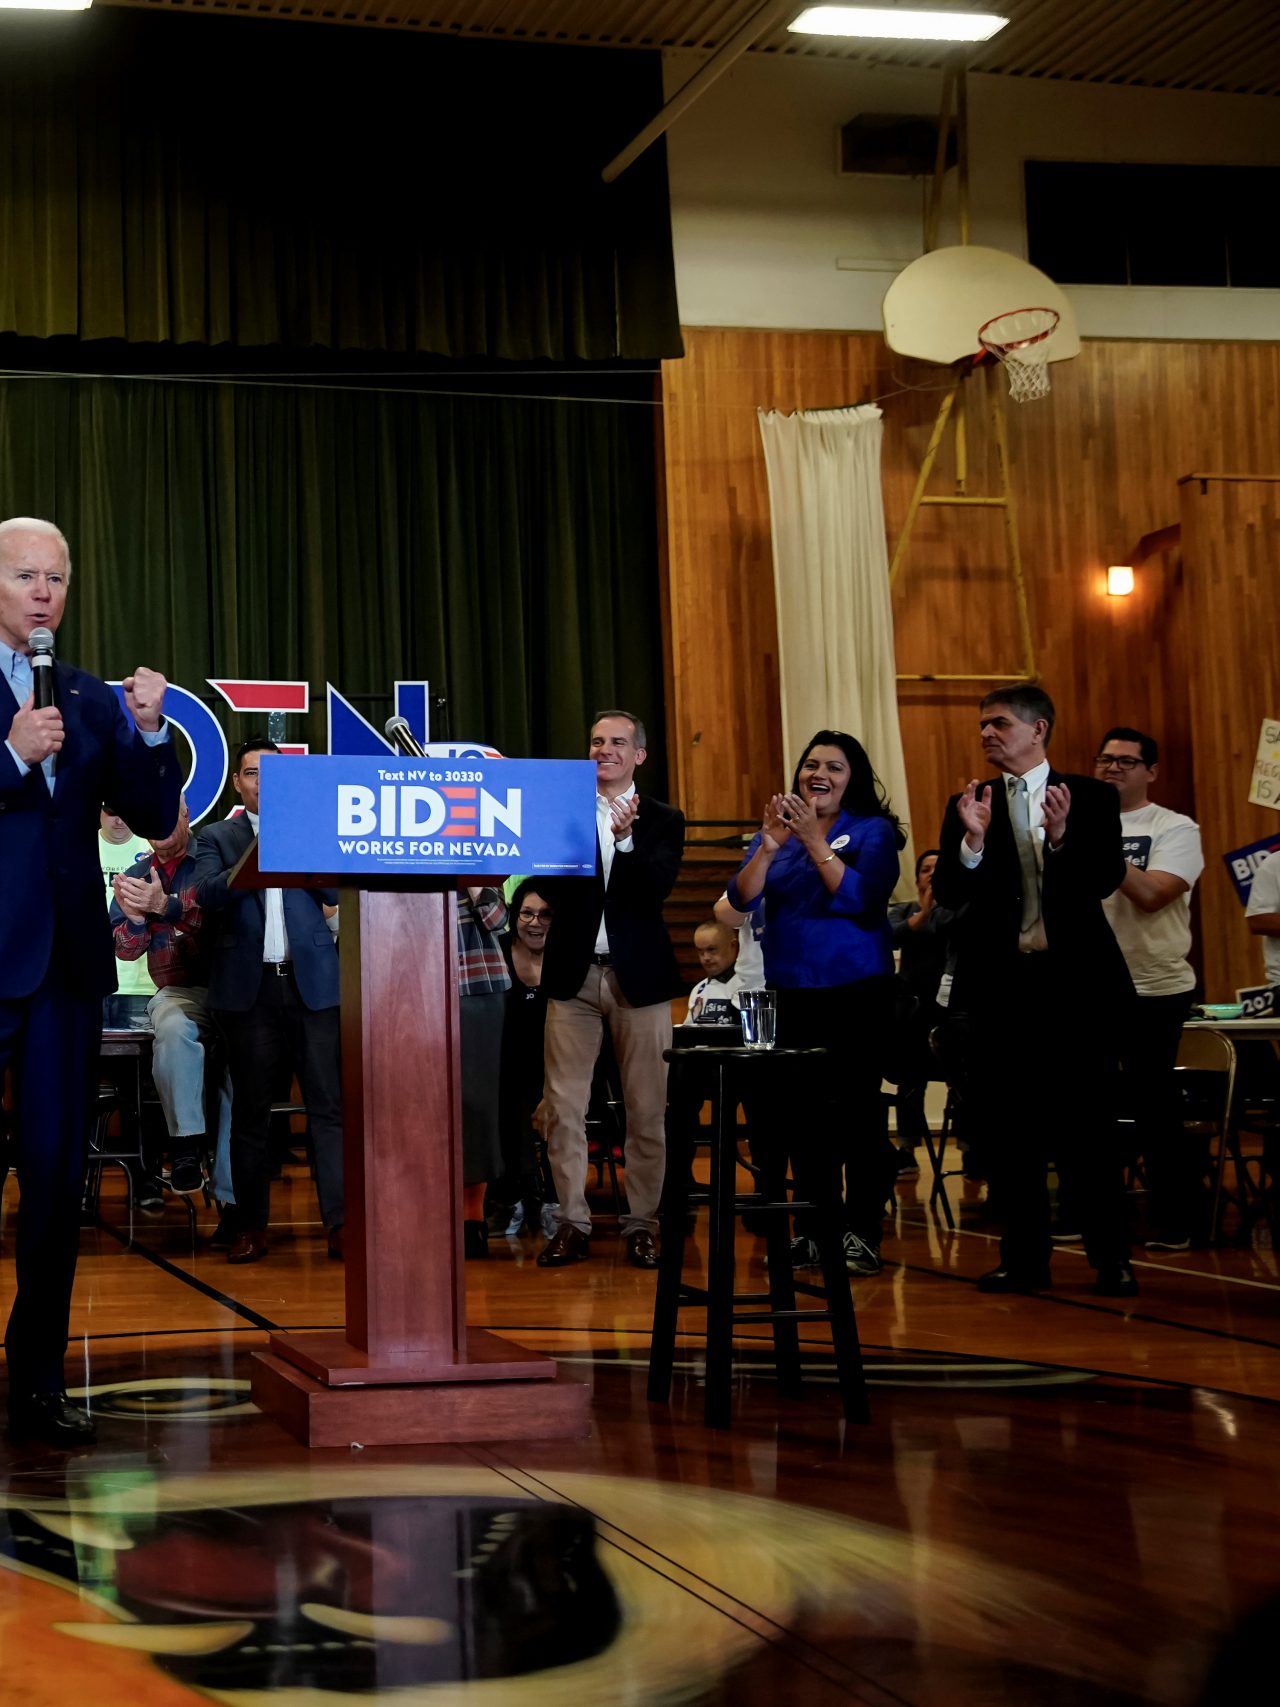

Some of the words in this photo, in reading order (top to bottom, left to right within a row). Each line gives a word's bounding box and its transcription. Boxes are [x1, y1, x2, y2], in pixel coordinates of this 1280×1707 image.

[377, 769, 405, 781] Text
[407, 770, 427, 781] NV
[429, 771, 442, 782] to
[444, 771, 483, 782] 30330
[337, 784, 522, 838] BIDEN
[338, 840, 405, 855] WORKS
[409, 841, 444, 856] FOR
[449, 842, 521, 857] NEVADA
